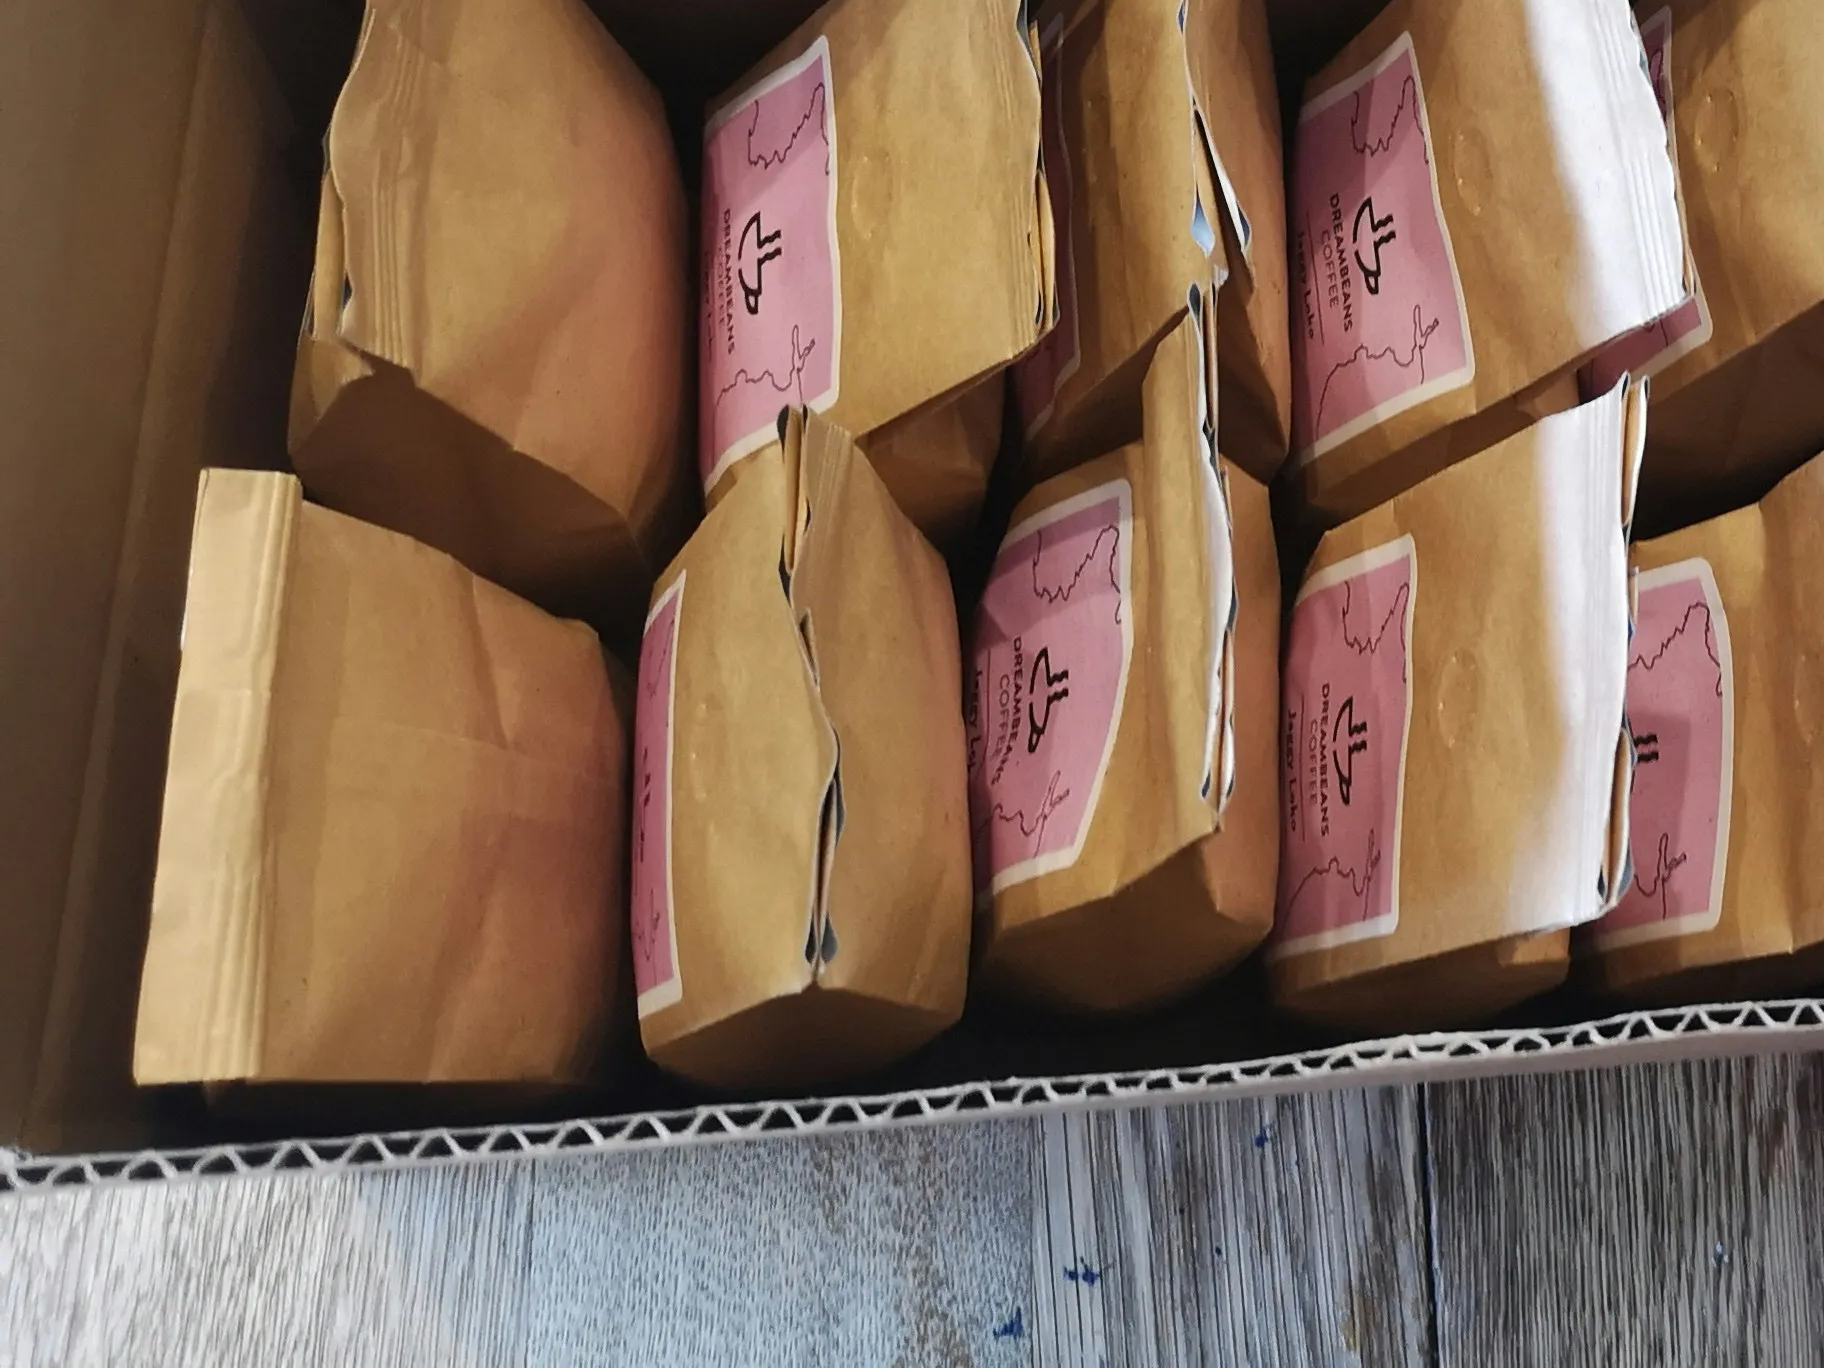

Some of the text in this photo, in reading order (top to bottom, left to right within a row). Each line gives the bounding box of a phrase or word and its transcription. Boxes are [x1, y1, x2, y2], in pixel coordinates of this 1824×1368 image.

[724, 209, 735, 354] DREAMBEANS
[1320, 229, 1340, 309] COFFEE
[1330, 193, 1353, 332] DREAMBEANS
[991, 636, 1022, 785] DREAMBEANS
[1309, 719, 1318, 805] COFFEE
[1320, 684, 1330, 836] DREAMBEANS
